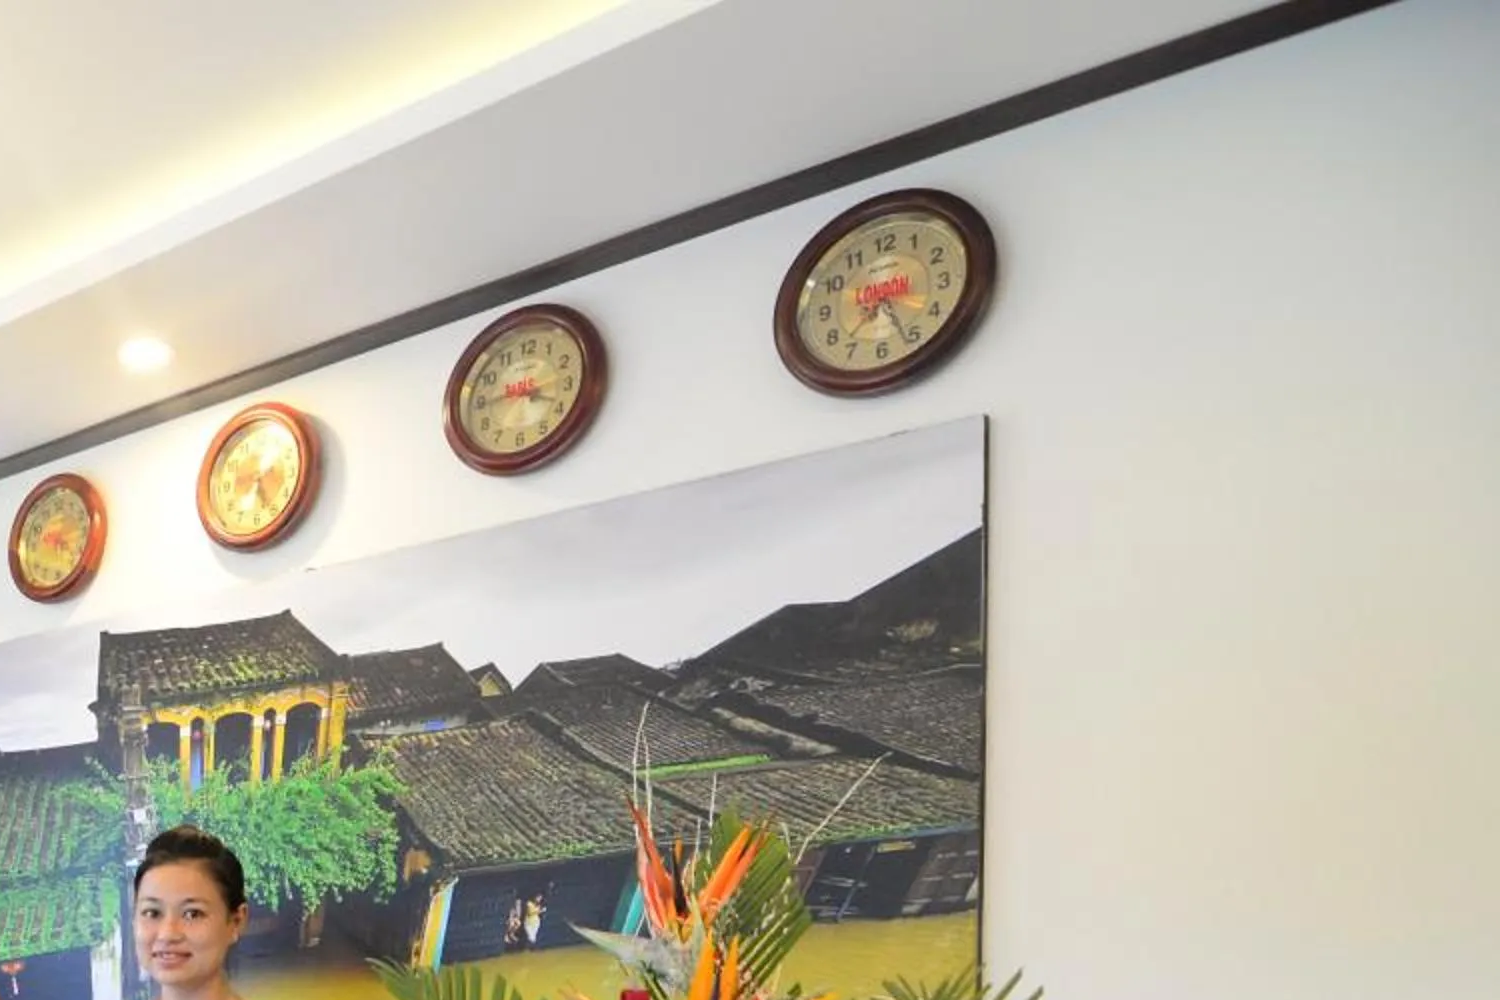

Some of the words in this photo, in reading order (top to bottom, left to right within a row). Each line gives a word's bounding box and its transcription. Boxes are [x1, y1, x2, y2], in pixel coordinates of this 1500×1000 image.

[874, 234, 897, 253] 12
[908, 234, 918, 250] 1
[845, 249, 863, 270] 11
[930, 247, 944, 265] 2
[825, 275, 845, 294] 10
[855, 272, 912, 306] LONDON
[937, 272, 951, 290] 3
[819, 305, 832, 321] 9
[928, 301, 941, 318] 4
[827, 329, 839, 346] 8
[908, 326, 921, 343] 5
[520, 339, 537, 355] 12
[545, 343, 552, 356] 1
[845, 342, 859, 359] 7
[875, 342, 889, 359] 6
[501, 351, 512, 365] 11
[560, 355, 570, 369] 2
[481, 372, 497, 386] 10
[563, 377, 573, 391] 3
[476, 396, 486, 409] 9
[554, 402, 564, 415] 4
[481, 417, 490, 430] 8
[538, 421, 548, 435] 5
[493, 430, 504, 443] 7
[515, 432, 525, 446] 6
